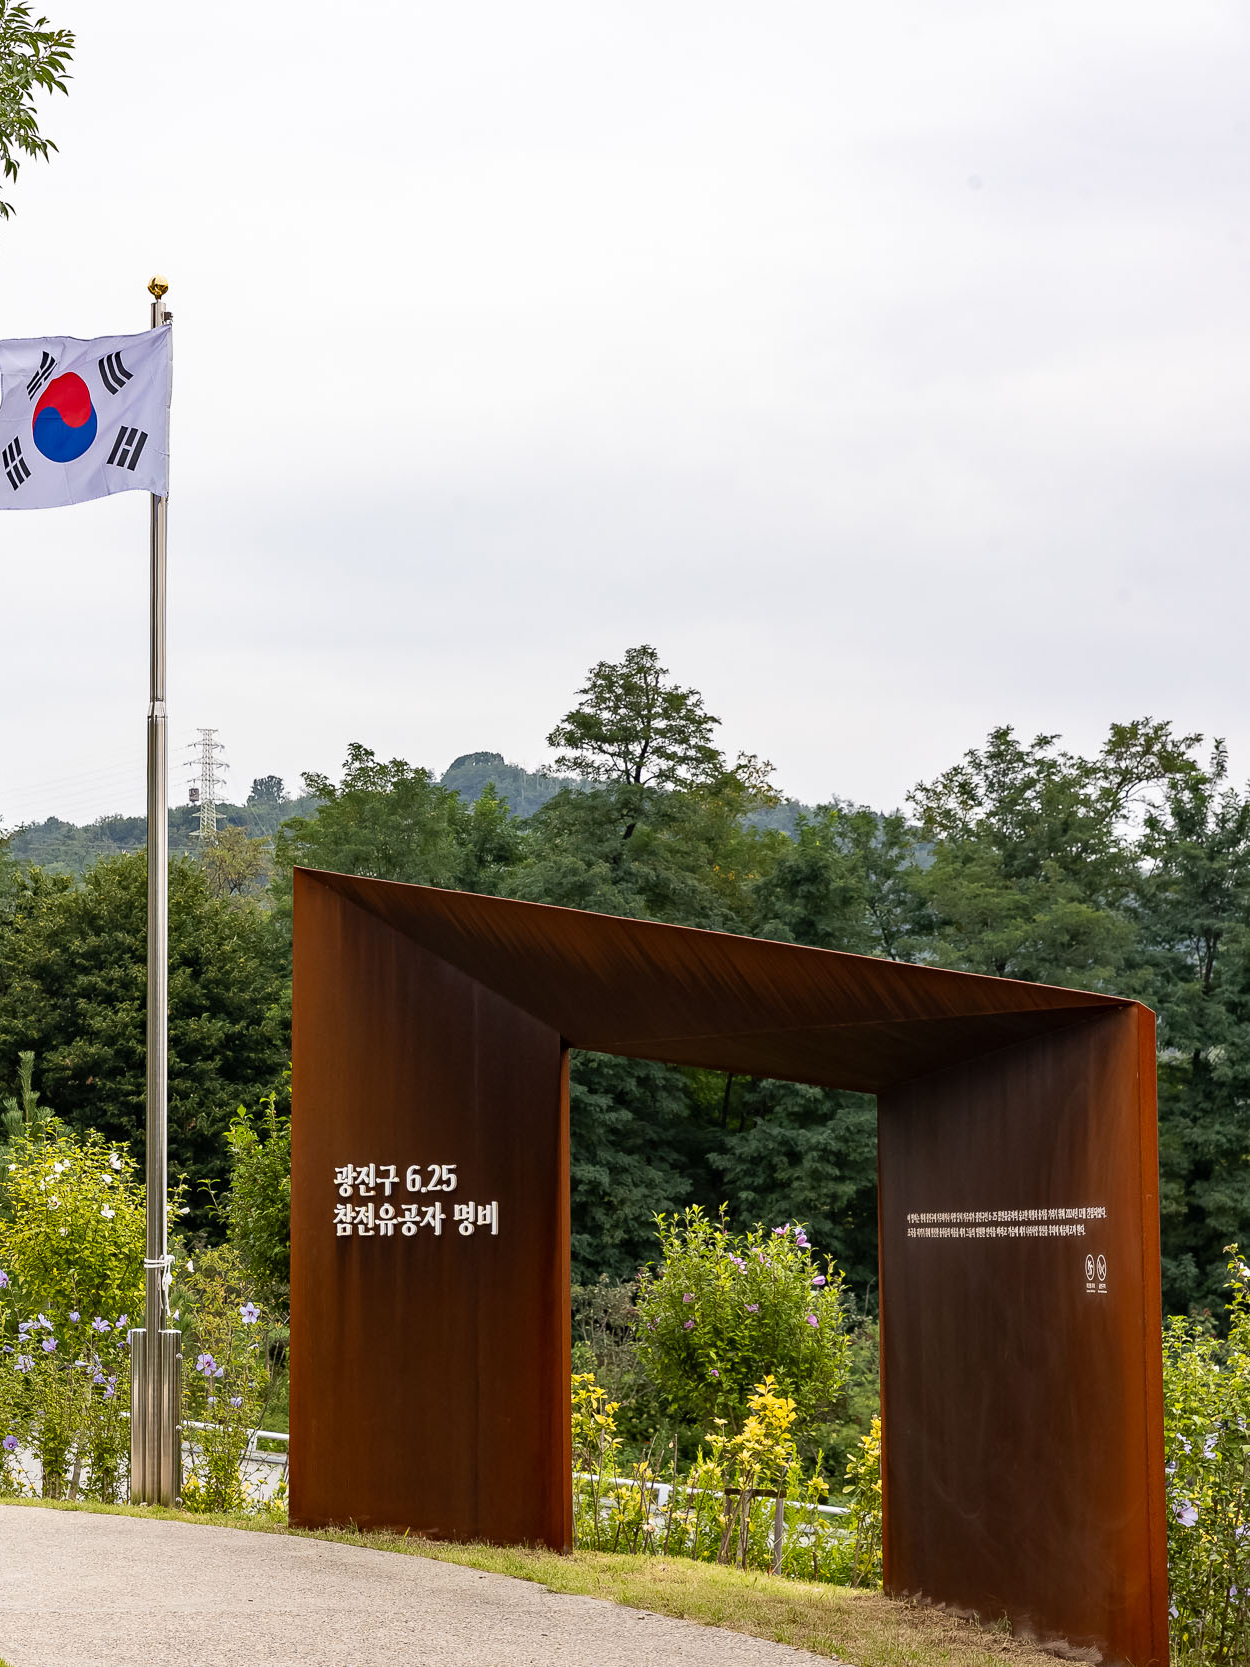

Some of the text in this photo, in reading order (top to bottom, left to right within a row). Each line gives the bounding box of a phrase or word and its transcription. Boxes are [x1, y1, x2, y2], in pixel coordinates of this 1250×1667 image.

[334, 1163, 457, 1197] 광진구 6.25
[333, 1201, 498, 1236] 참전유공자 명비
